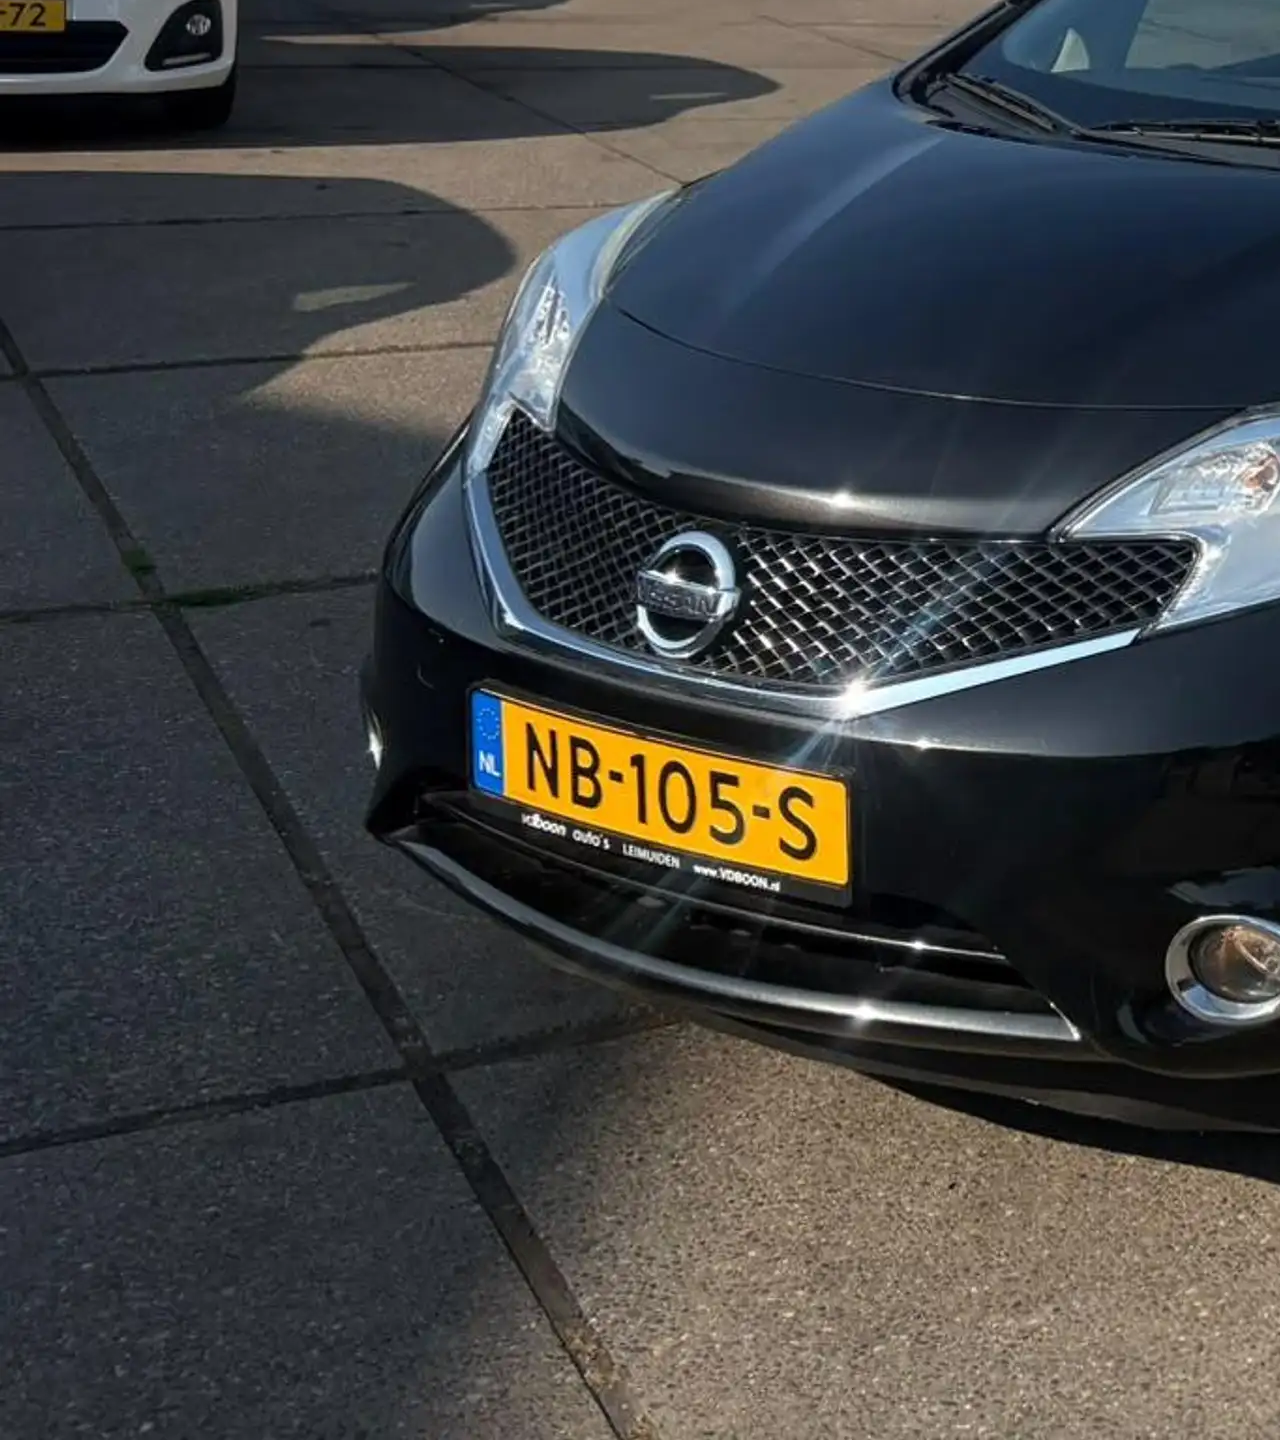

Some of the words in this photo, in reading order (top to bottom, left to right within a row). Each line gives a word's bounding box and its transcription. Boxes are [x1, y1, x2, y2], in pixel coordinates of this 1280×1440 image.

[479, 750, 501, 777] NL
[525, 721, 818, 862] NB-105-S
[623, 844, 680, 868] LEIMUIDEN
